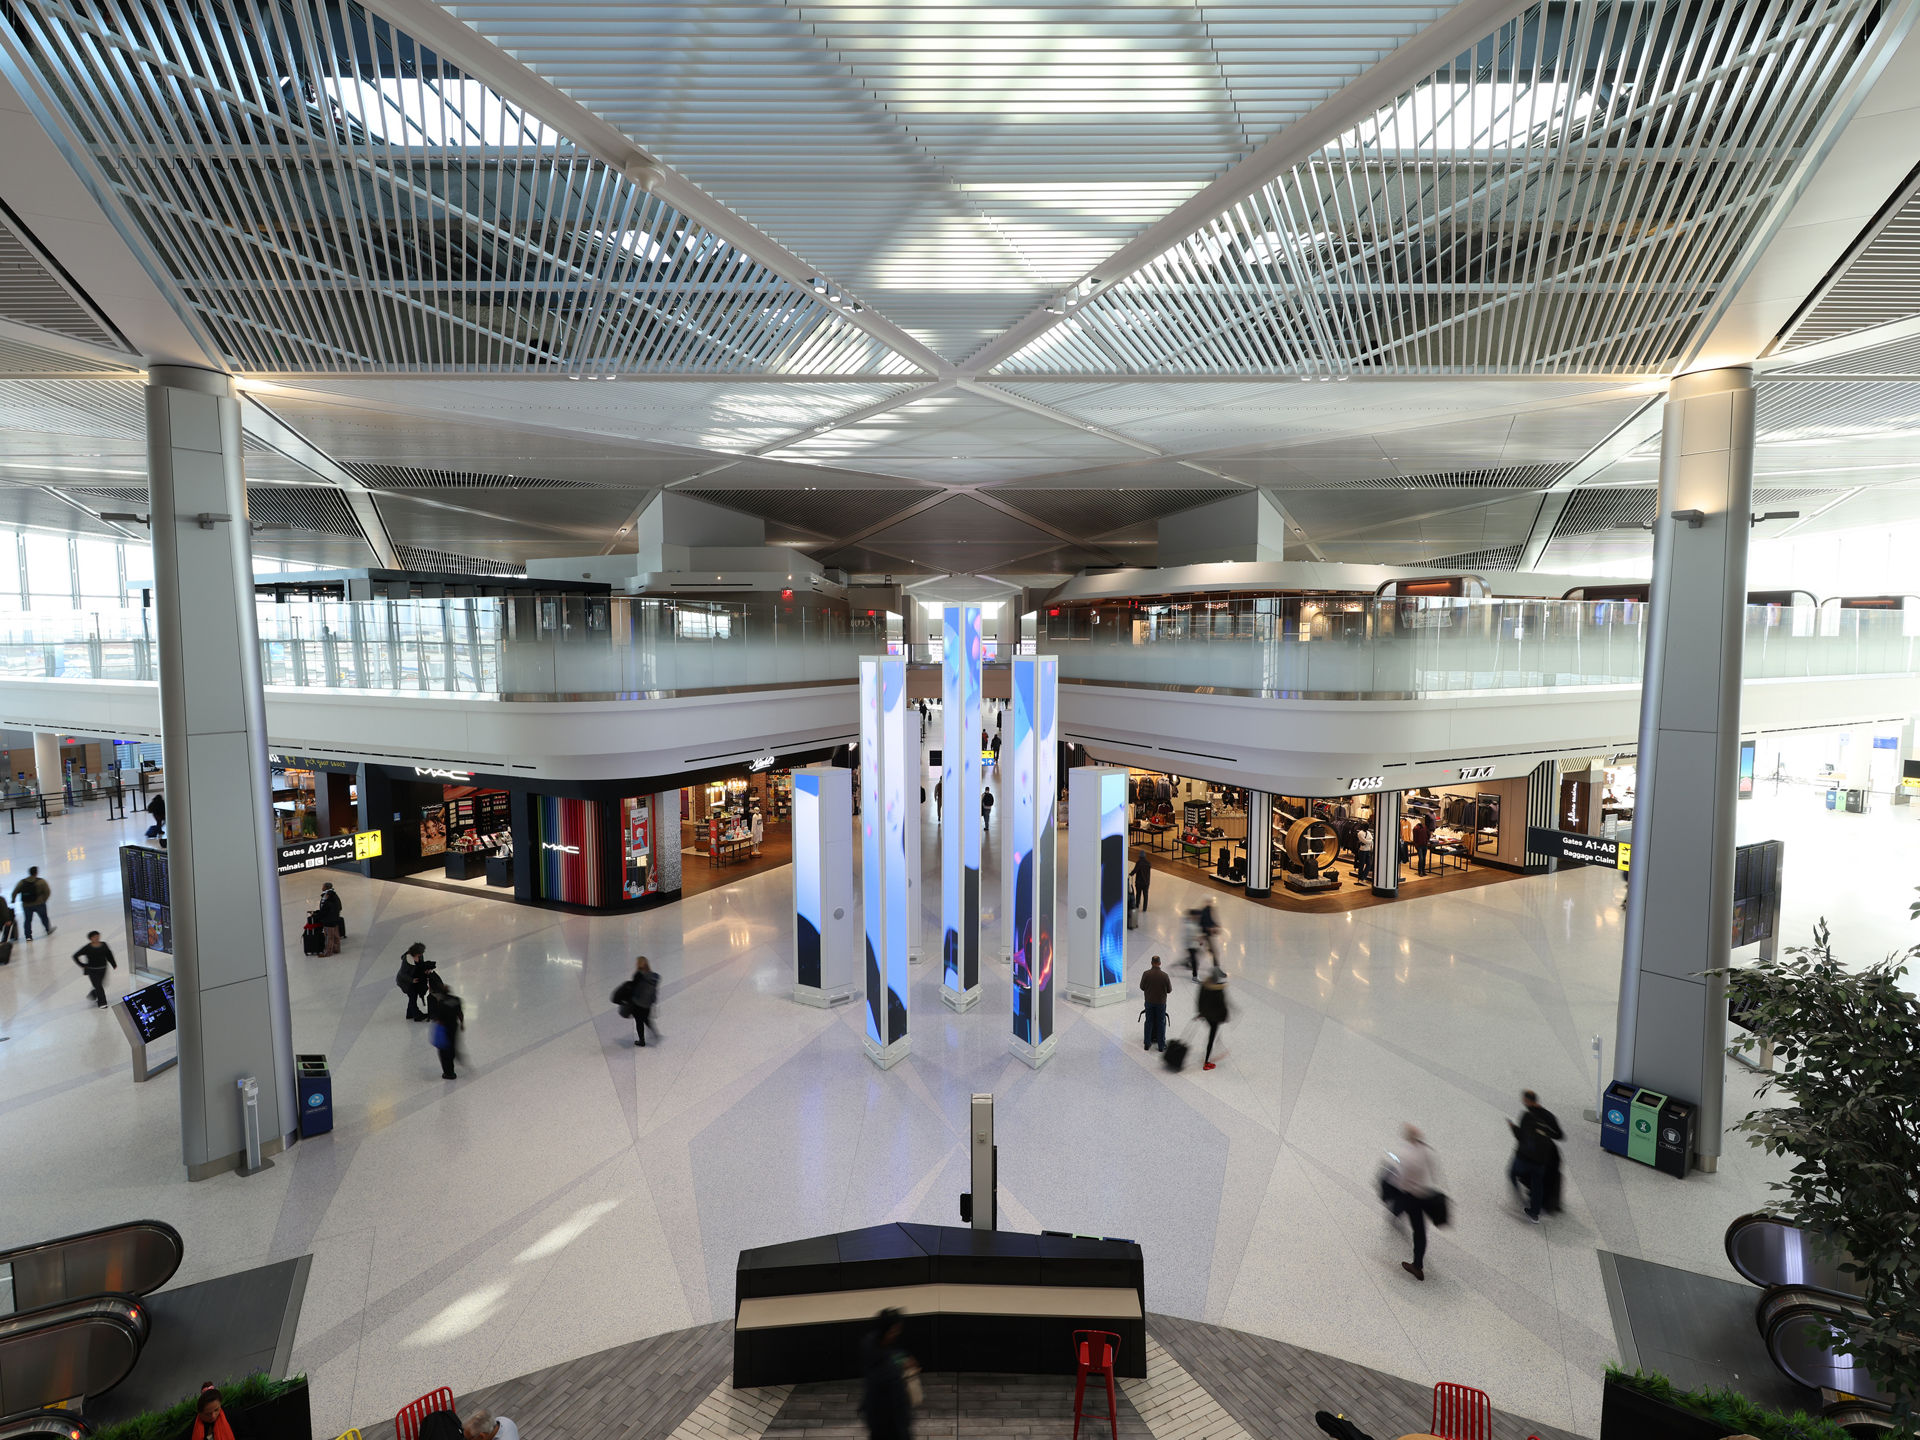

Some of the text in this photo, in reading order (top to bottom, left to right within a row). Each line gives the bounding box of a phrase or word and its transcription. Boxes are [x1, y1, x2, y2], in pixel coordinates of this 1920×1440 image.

[1349, 776, 1384, 791] BOSS
[282, 837, 353, 857] Gates A27-A34
[1562, 837, 1616, 853] Gates A1-A8
[1563, 849, 1615, 865] Baggage Claim
